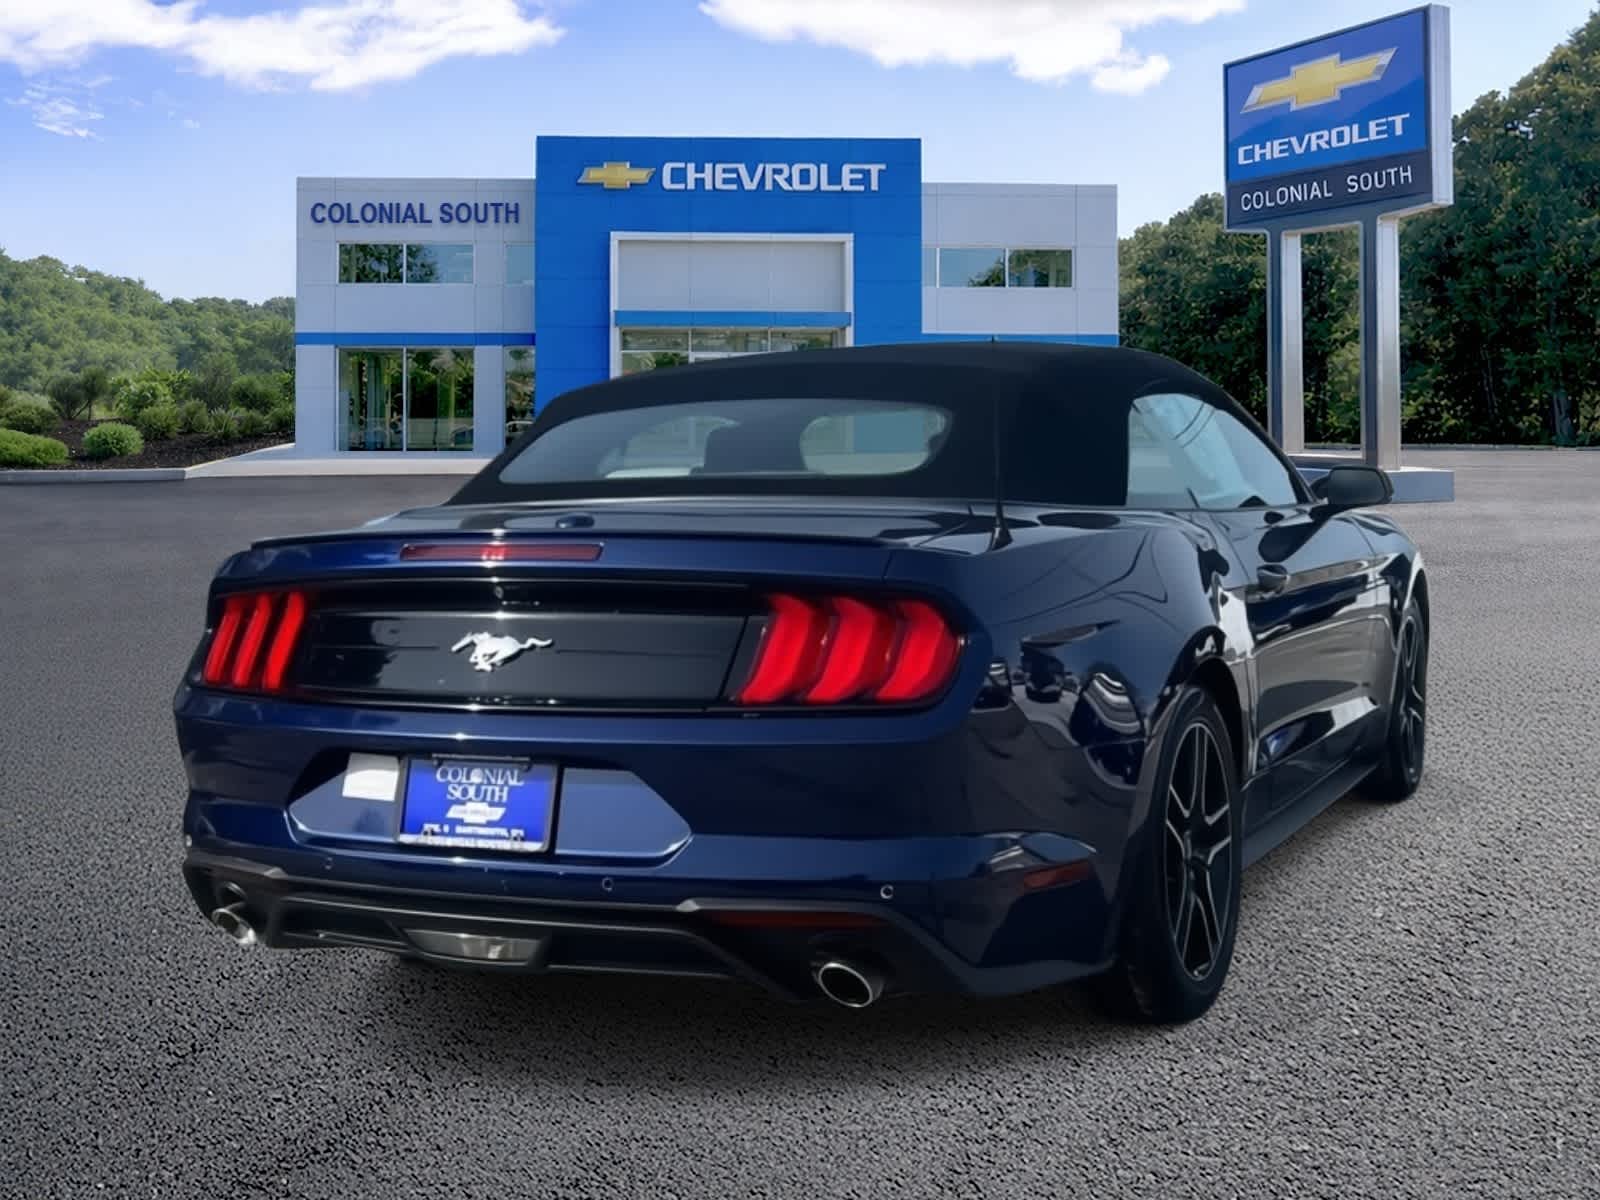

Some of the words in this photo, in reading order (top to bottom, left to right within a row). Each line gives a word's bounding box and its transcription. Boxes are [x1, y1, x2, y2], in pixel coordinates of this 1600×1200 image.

[1238, 113, 1410, 165] CHEVROLET
[661, 161, 886, 192] CHEVROLET
[1241, 180, 1333, 211] COLONIAL
[1347, 165, 1412, 193] SOUTH
[310, 203, 432, 224] COLONIAL
[439, 203, 520, 224] SOUTH
[436, 766, 524, 786] COLONIAL
[446, 783, 509, 803] SOUTH
